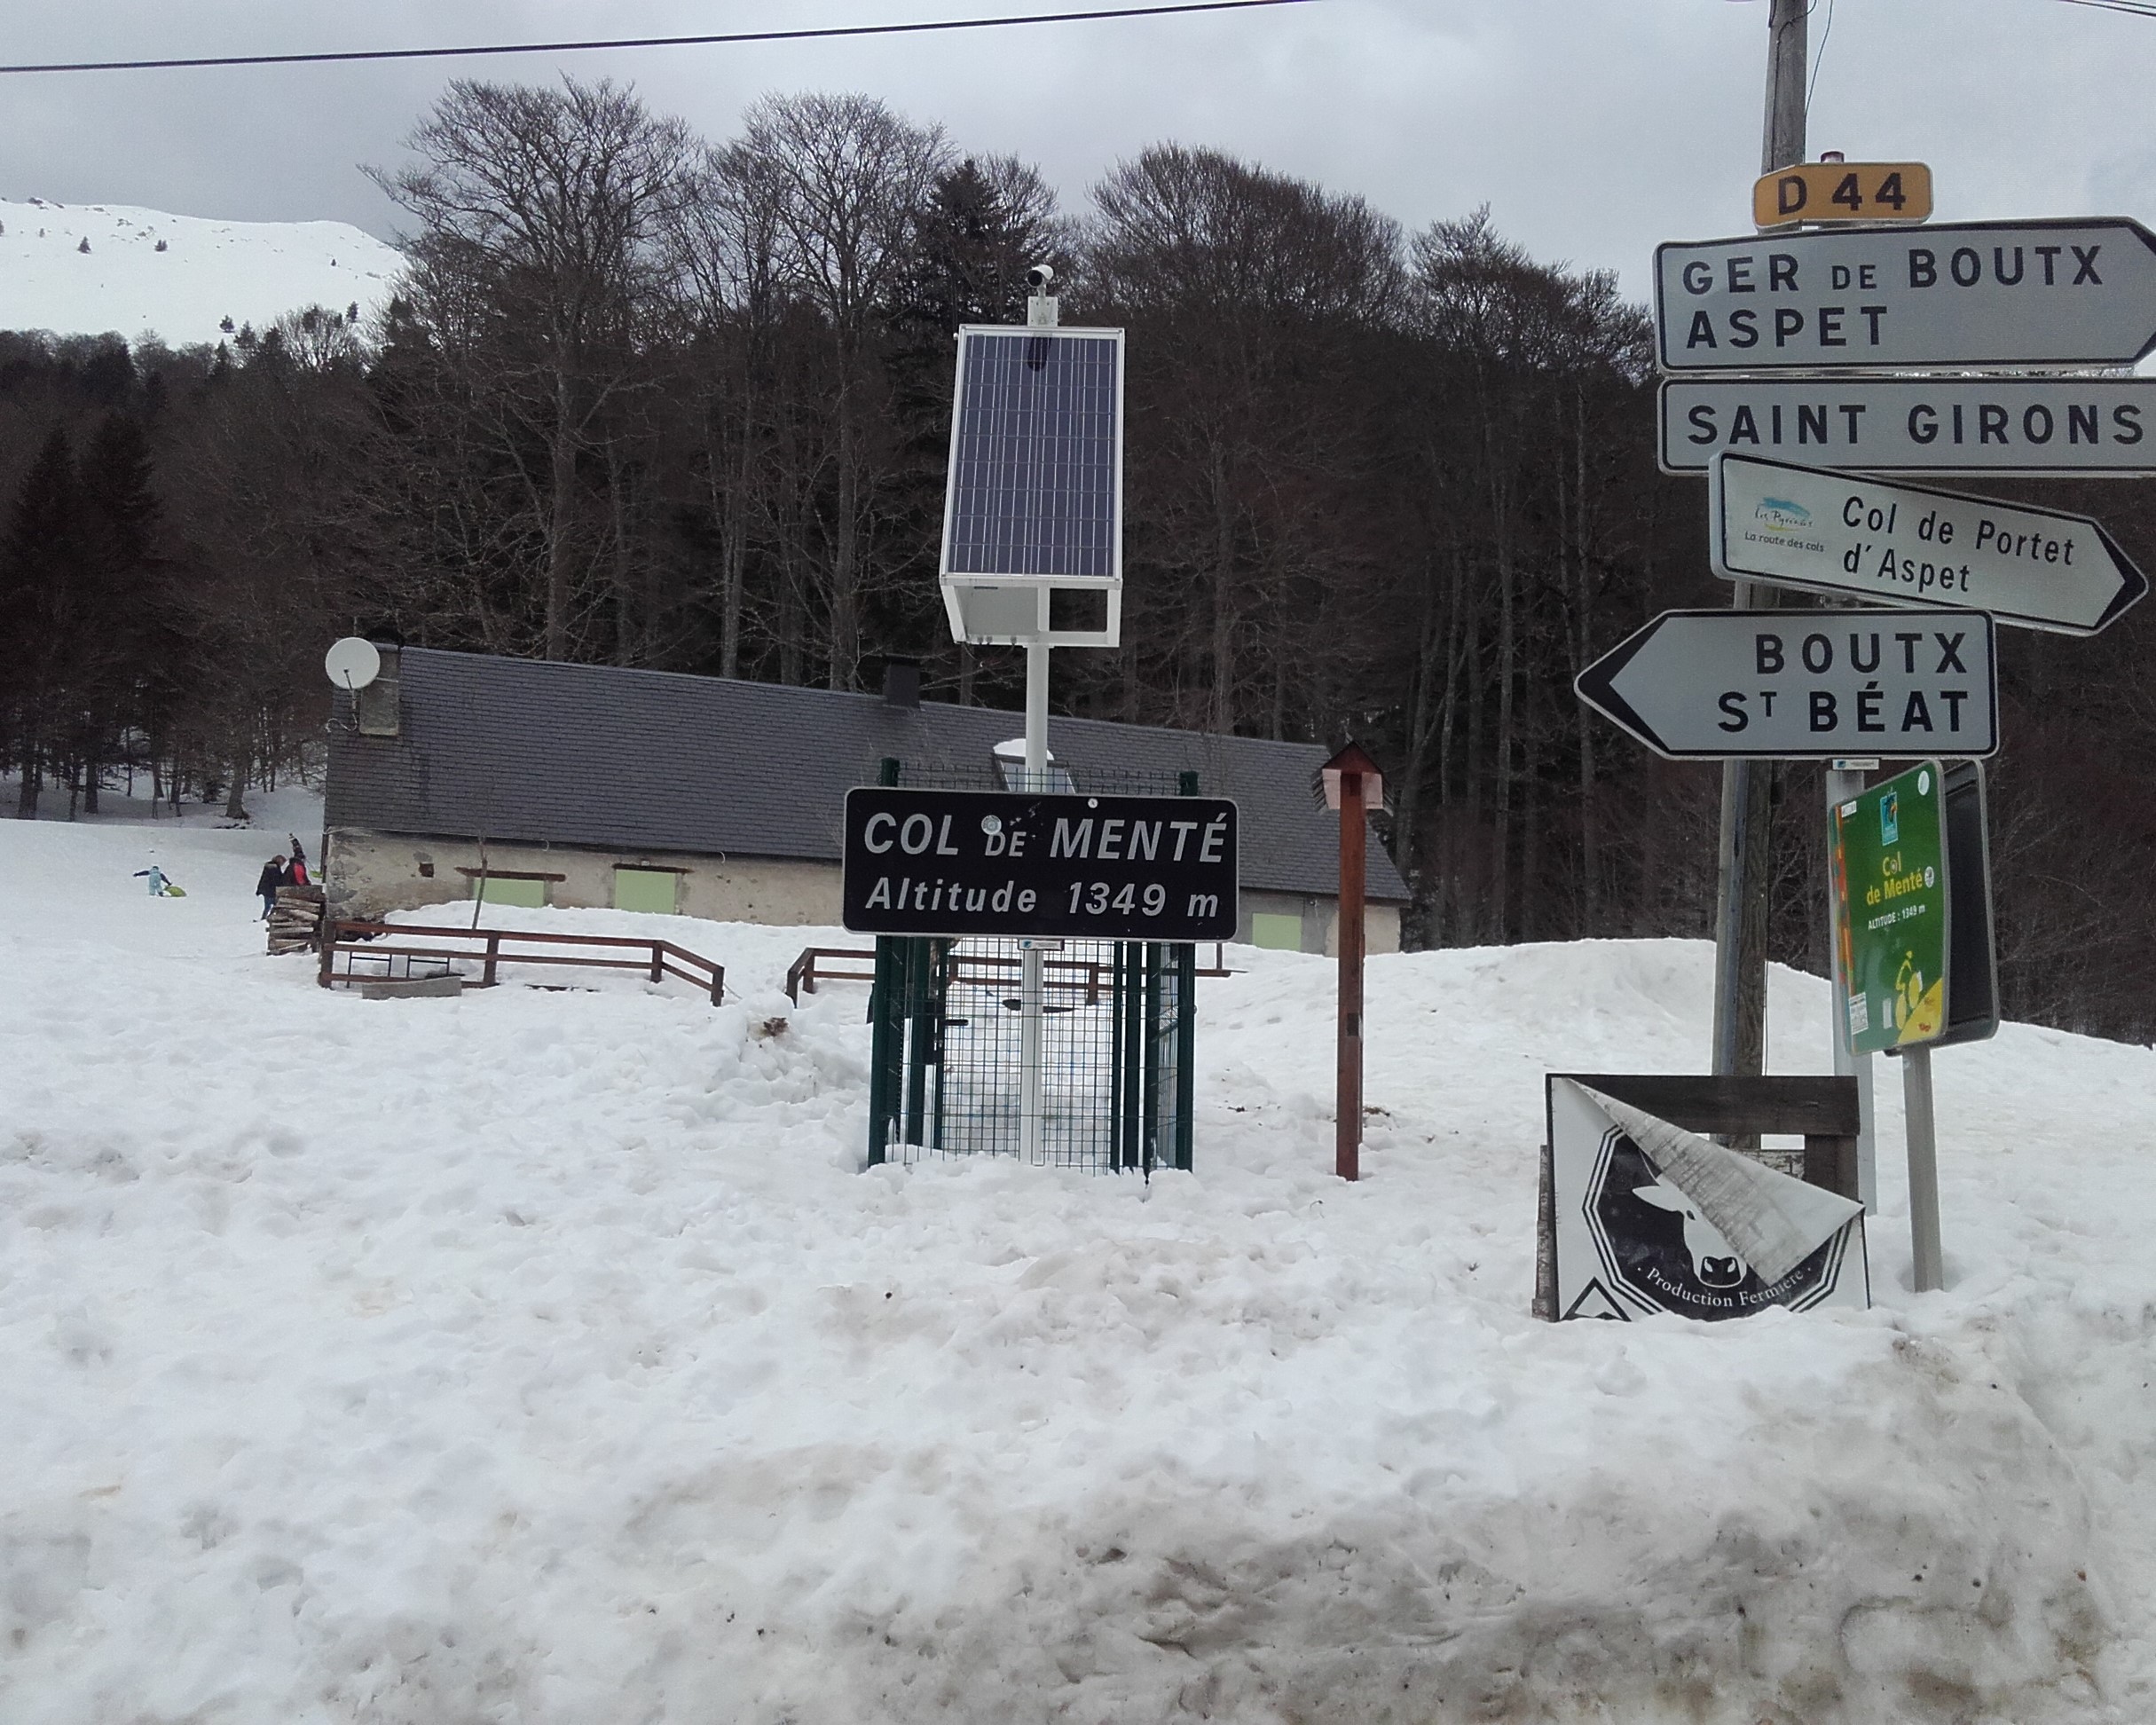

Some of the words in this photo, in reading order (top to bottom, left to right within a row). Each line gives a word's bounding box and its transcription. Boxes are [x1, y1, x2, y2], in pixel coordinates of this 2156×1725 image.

[1778, 176, 1806, 216] D
[1831, 171, 1906, 211] 44
[1682, 253, 1799, 295] GER
[1831, 264, 1877, 290] DE
[1909, 245, 2103, 288] BOUTX
[1687, 305, 1887, 349] ASPET
[1688, 404, 1866, 445] SAINT
[1908, 404, 2144, 445] GIRONS
[1744, 531, 1756, 540] La
[1759, 534, 1785, 546] route
[1787, 538, 1804, 548] des
[1806, 541, 1824, 553] cols
[1843, 495, 1897, 534] Col
[1919, 509, 1954, 544] de
[1976, 519, 2074, 565] Portet
[1755, 633, 1967, 674] BOUTX
[1809, 681, 1968, 733] BÉAT
[864, 812, 959, 855] COL
[985, 831, 1027, 857] DE
[1049, 812, 1228, 862] MENTÉ
[1883, 851, 1902, 877] Col
[865, 877, 1036, 912] Altitude
[1068, 882, 1166, 916] 1349
[1186, 894, 1218, 918] m
[1866, 885, 1881, 906] de
[1885, 867, 1924, 900] Menté
[1868, 911, 1897, 930] ALTITUDE
[1901, 904, 1917, 919] 1349
[1647, 1267, 1733, 1307] Production
